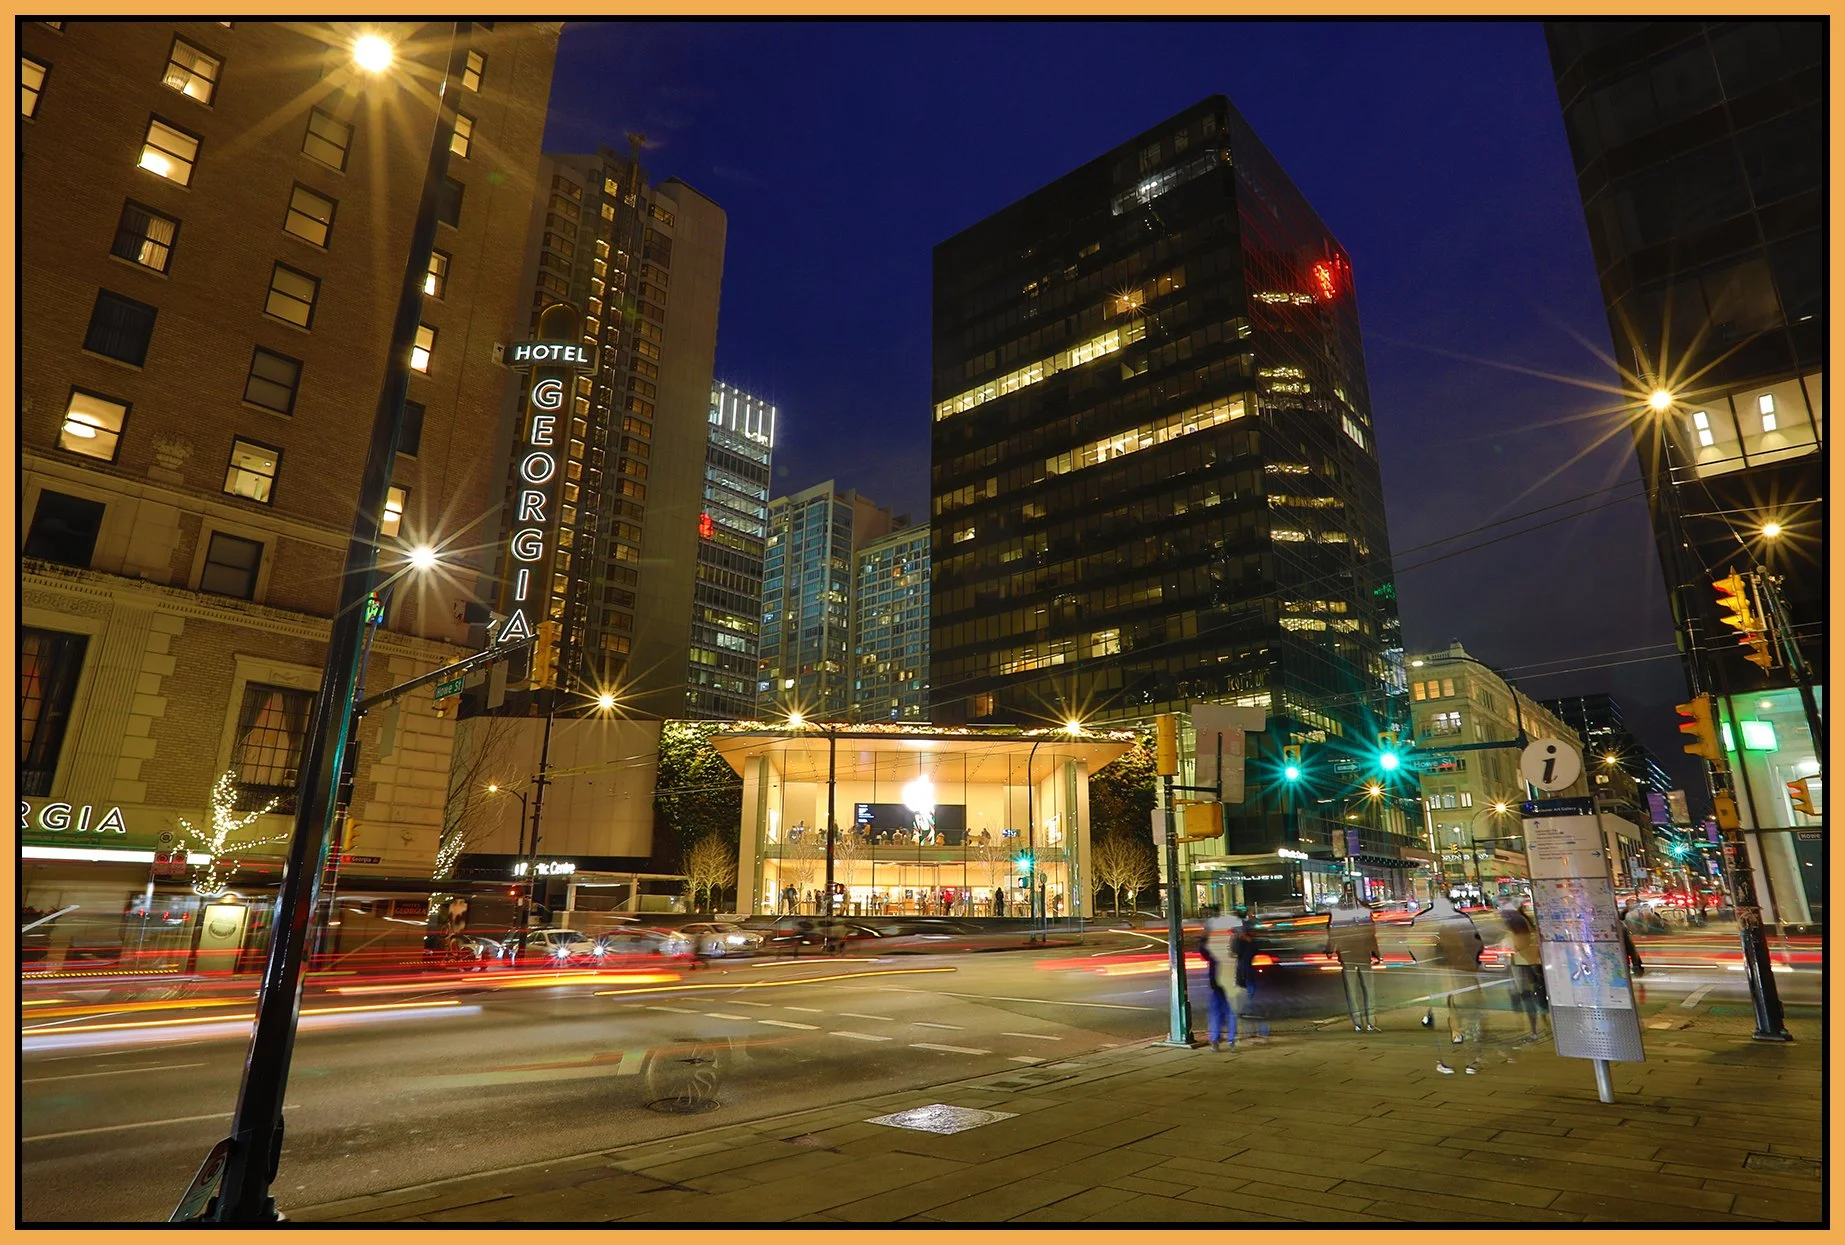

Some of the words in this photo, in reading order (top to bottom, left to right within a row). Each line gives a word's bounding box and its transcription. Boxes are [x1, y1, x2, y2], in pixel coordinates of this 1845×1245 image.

[515, 344, 588, 363] HOTEL
[498, 378, 563, 642] GEORGIA
[1413, 760, 1438, 768] Howe
